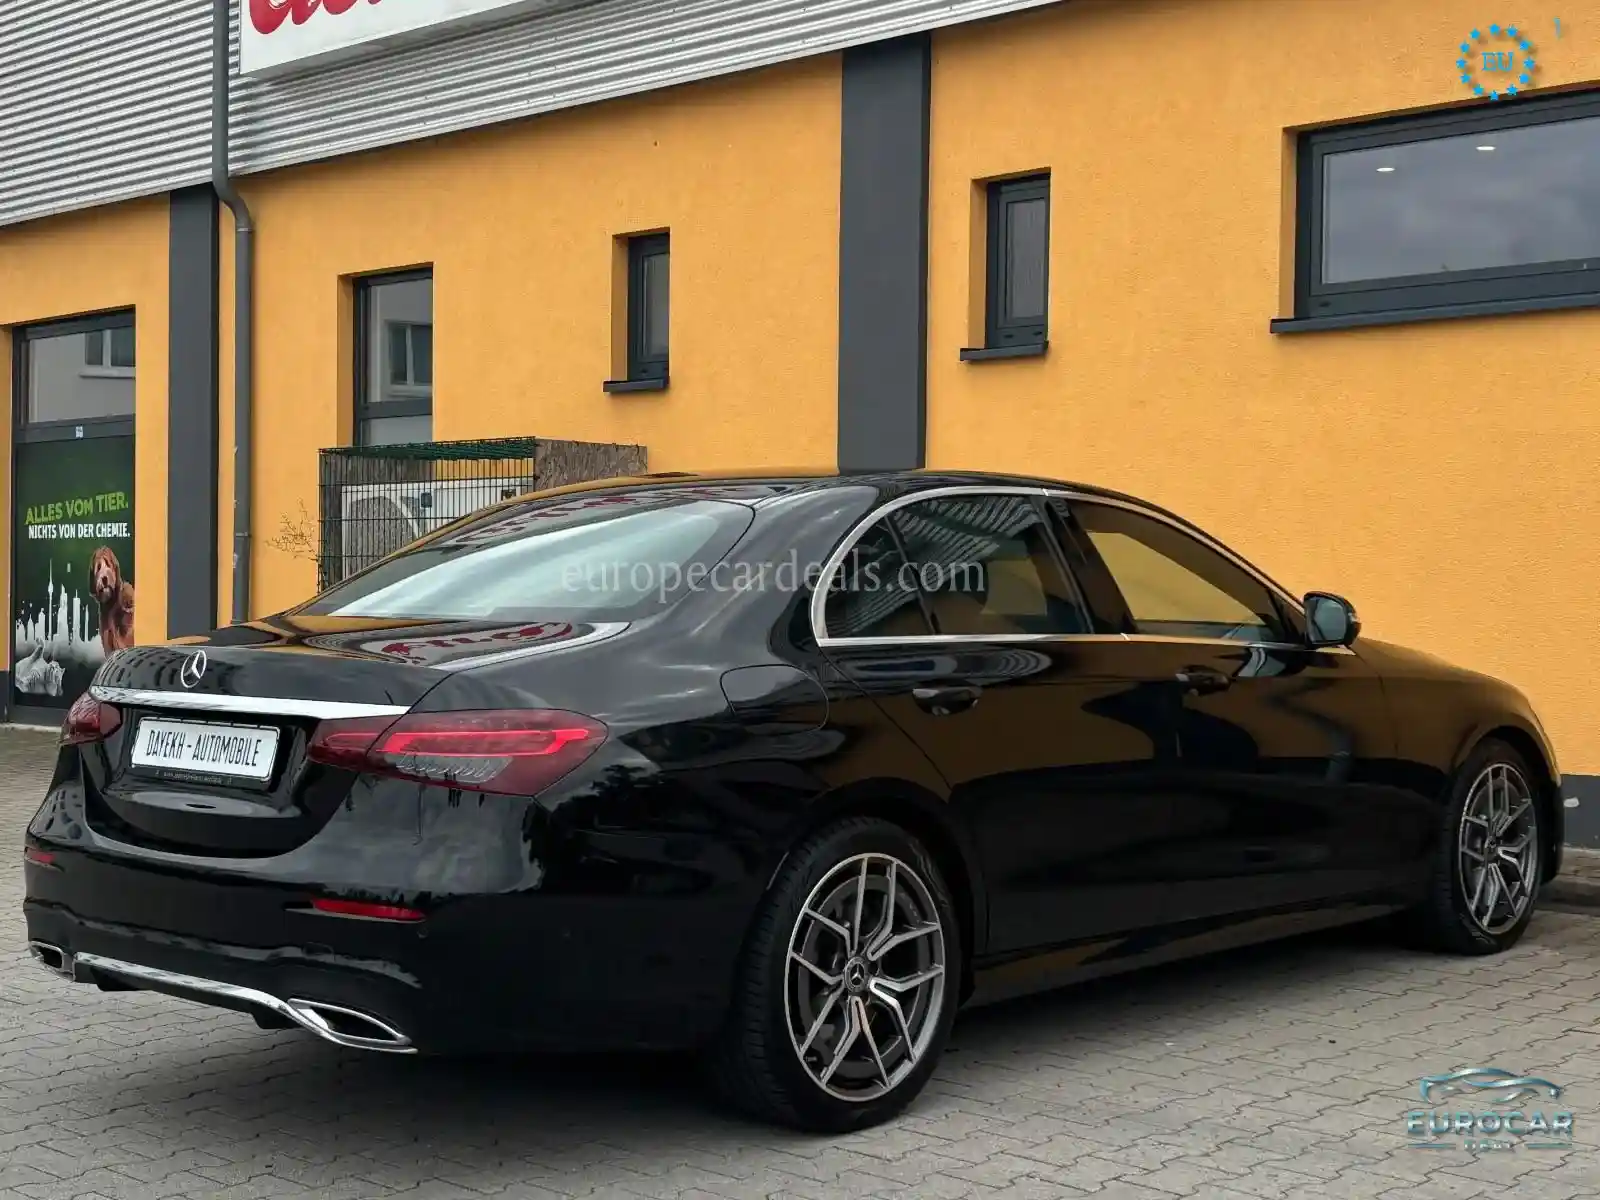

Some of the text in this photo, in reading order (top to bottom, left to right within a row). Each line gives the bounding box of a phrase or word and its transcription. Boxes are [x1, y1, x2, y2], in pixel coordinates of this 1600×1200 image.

[25, 491, 129, 525] ALLES VOM TIER.
[28, 522, 130, 539] NICHTS VON DER CHEMIE.
